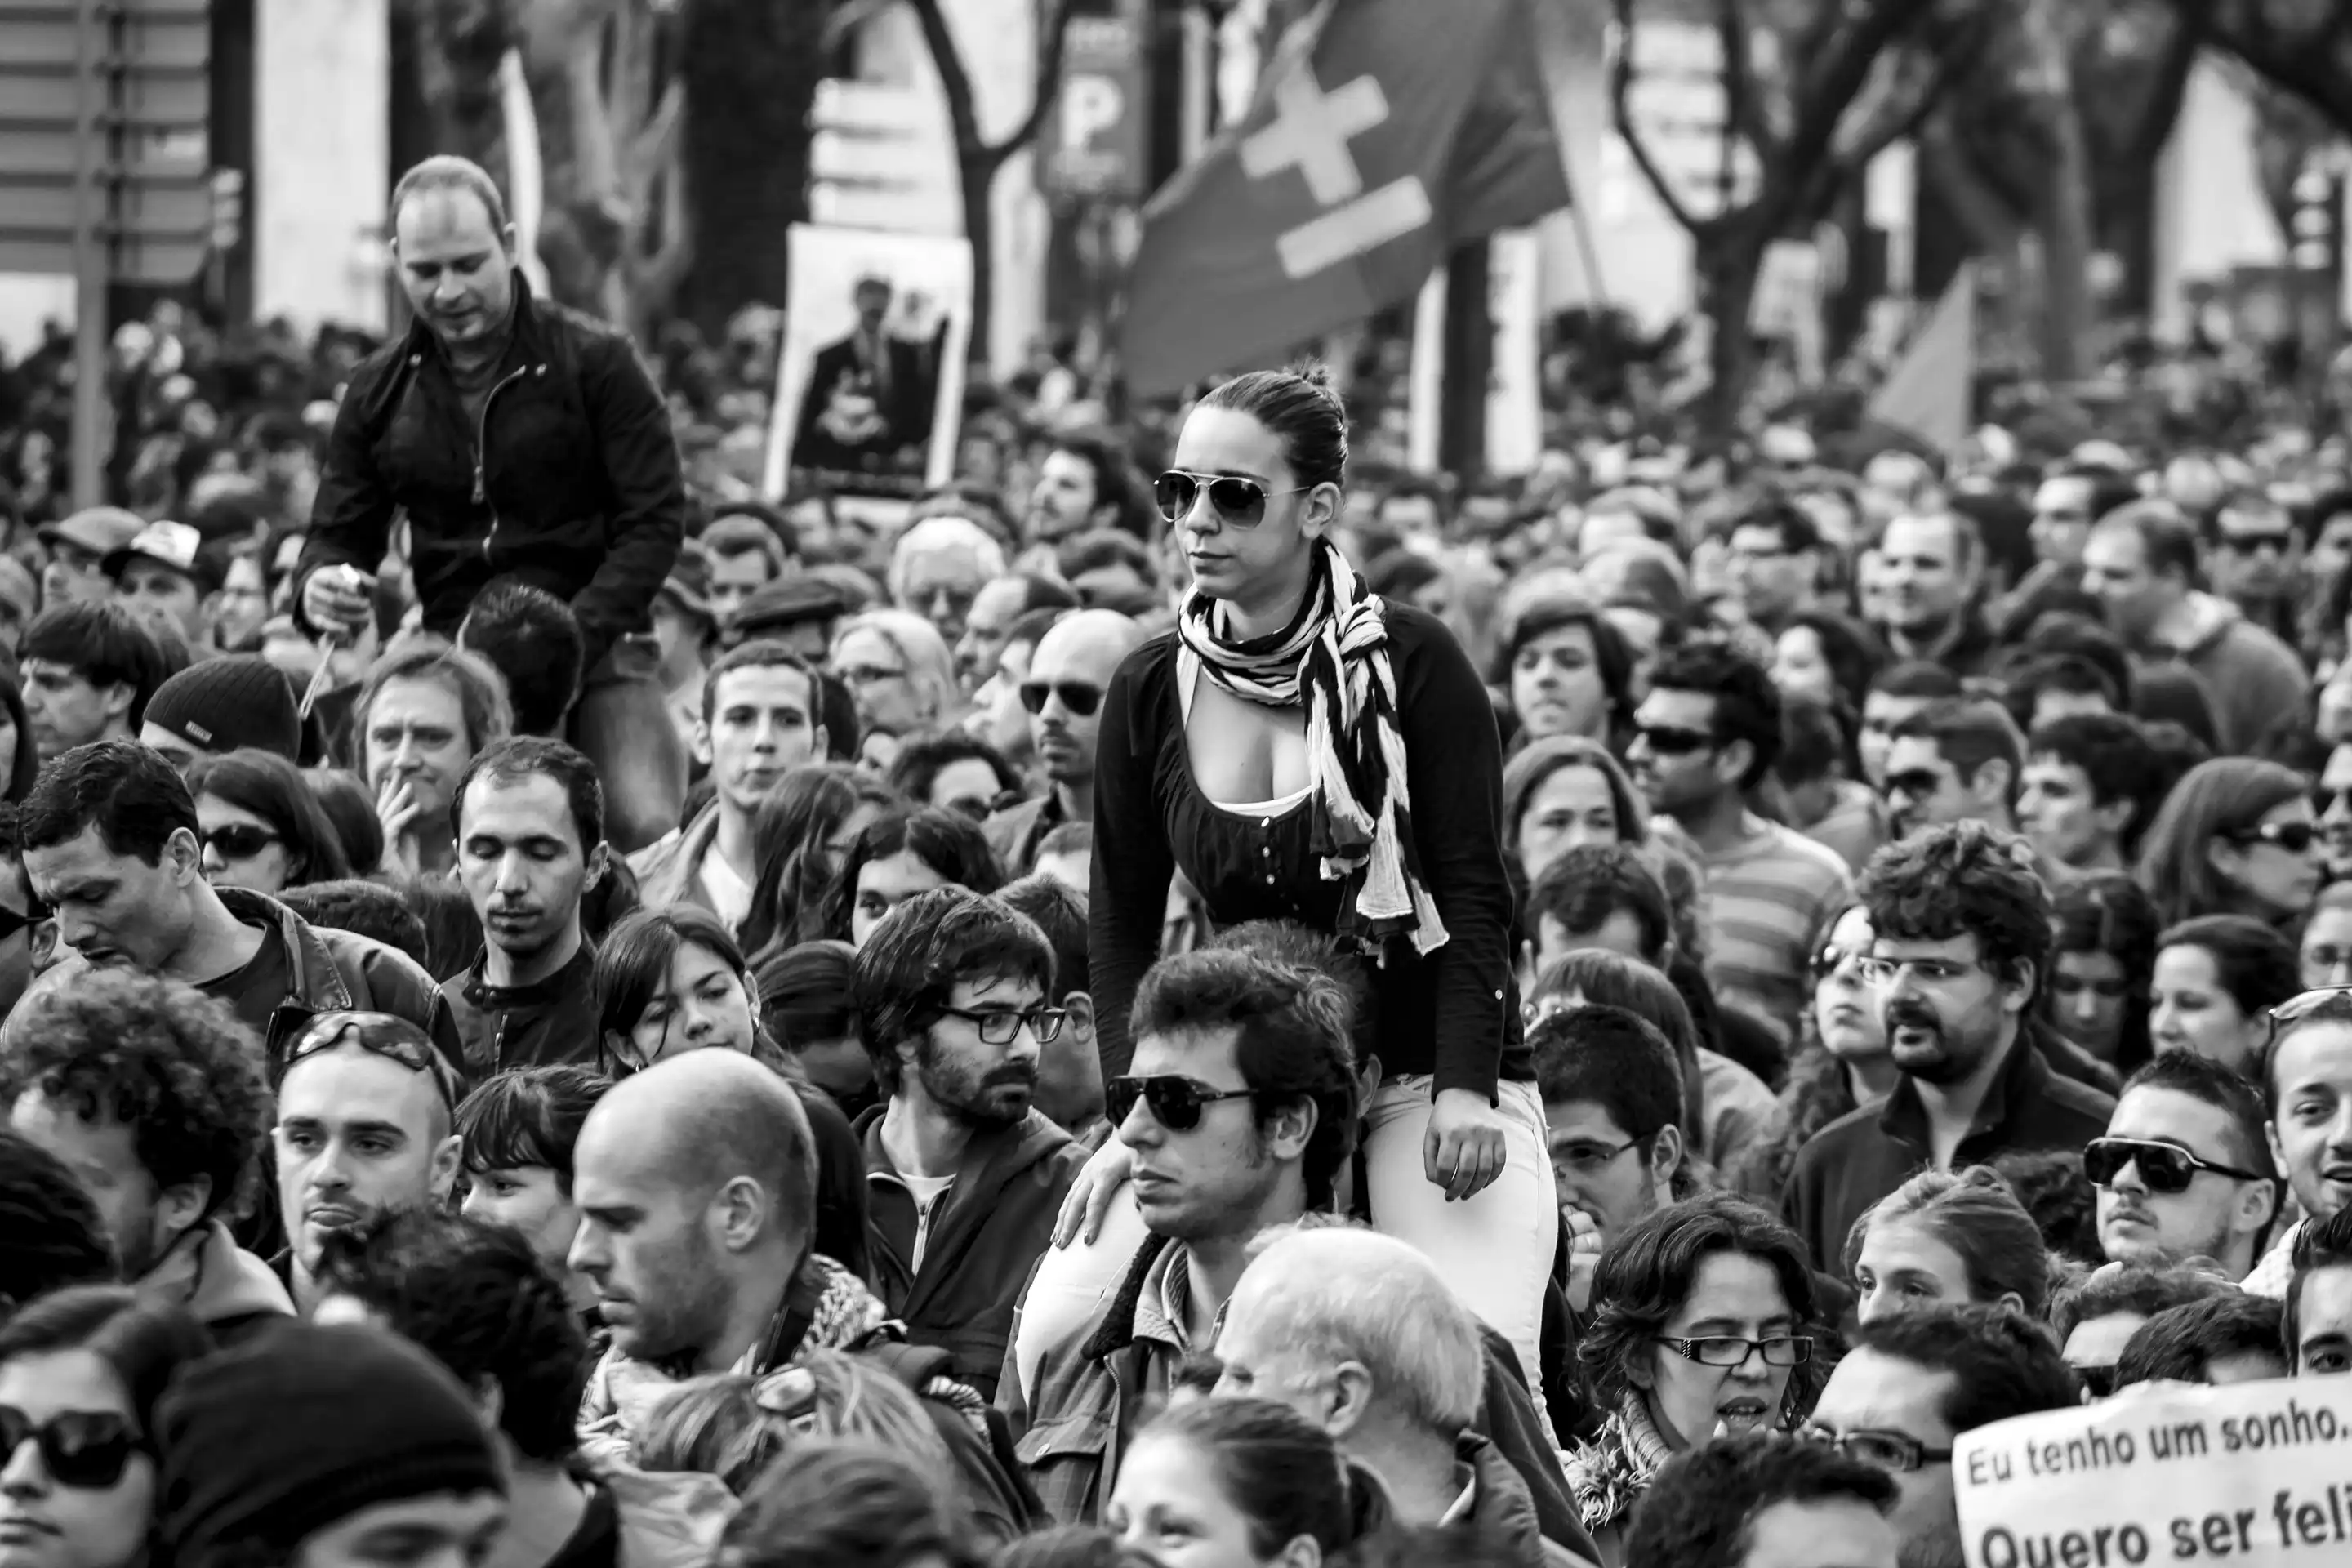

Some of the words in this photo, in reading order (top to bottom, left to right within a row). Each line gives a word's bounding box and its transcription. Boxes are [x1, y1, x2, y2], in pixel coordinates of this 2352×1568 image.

[1062, 74, 1125, 150] P
[1967, 1448, 2014, 1486] Eu
[2026, 1425, 2136, 1476] tenho
[2148, 1419, 2209, 1463] um
[1980, 1522, 2151, 1568] Quero
[2168, 1506, 2256, 1561] ser
